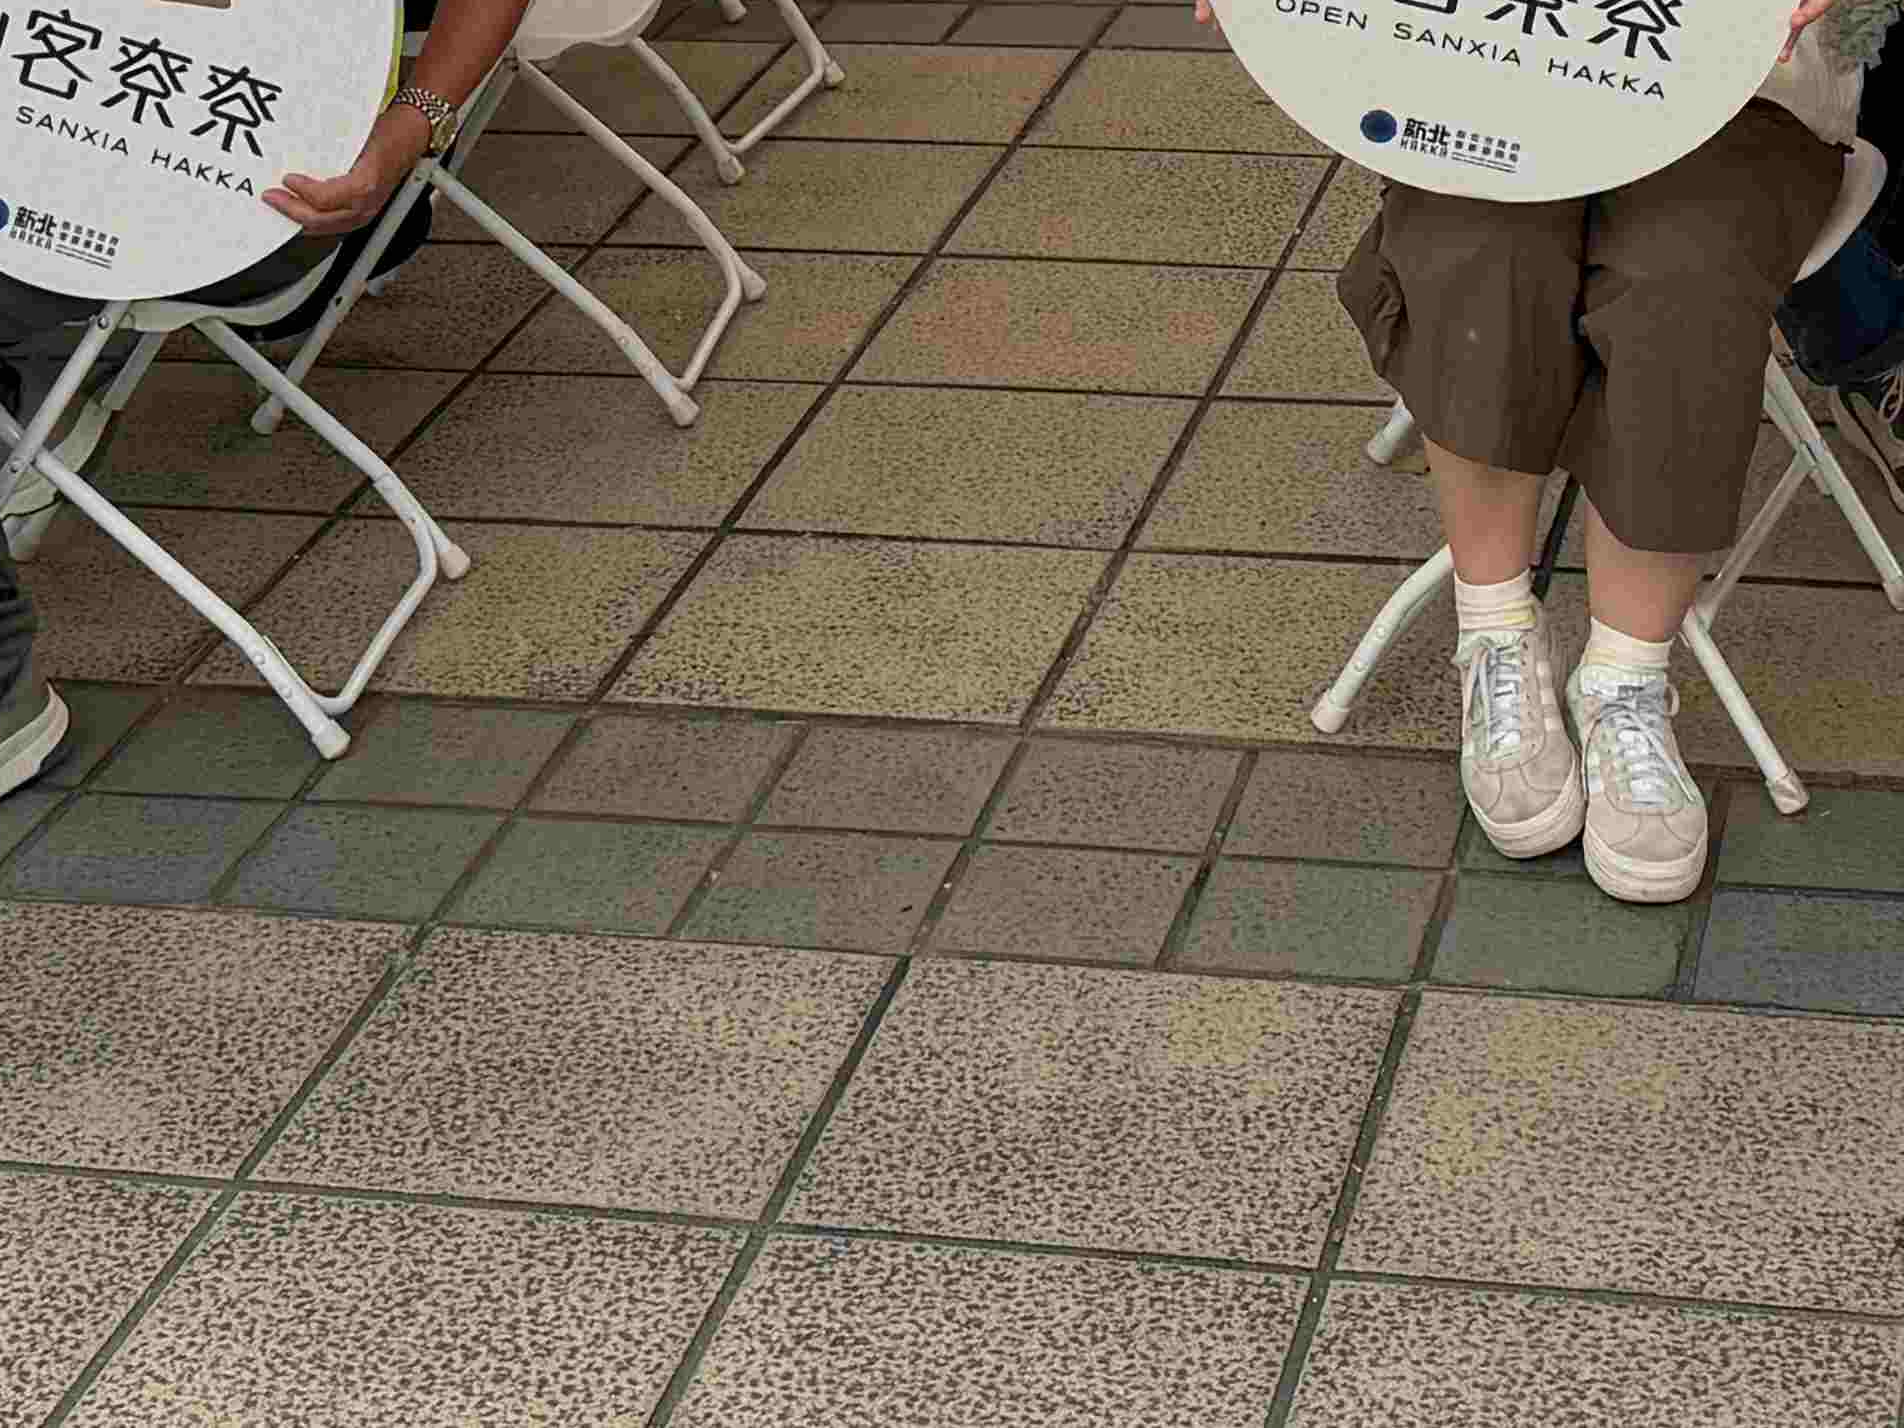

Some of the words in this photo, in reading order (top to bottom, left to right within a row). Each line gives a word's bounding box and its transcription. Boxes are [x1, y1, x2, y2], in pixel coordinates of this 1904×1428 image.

[1393, 22, 1522, 67] SANXIA
[1547, 58, 1666, 99] HAKKA
[16, 106, 130, 156] SANXIA
[151, 148, 255, 197] HAKKA
[1403, 118, 1451, 146] 新北
[14, 206, 57, 237] 新北
